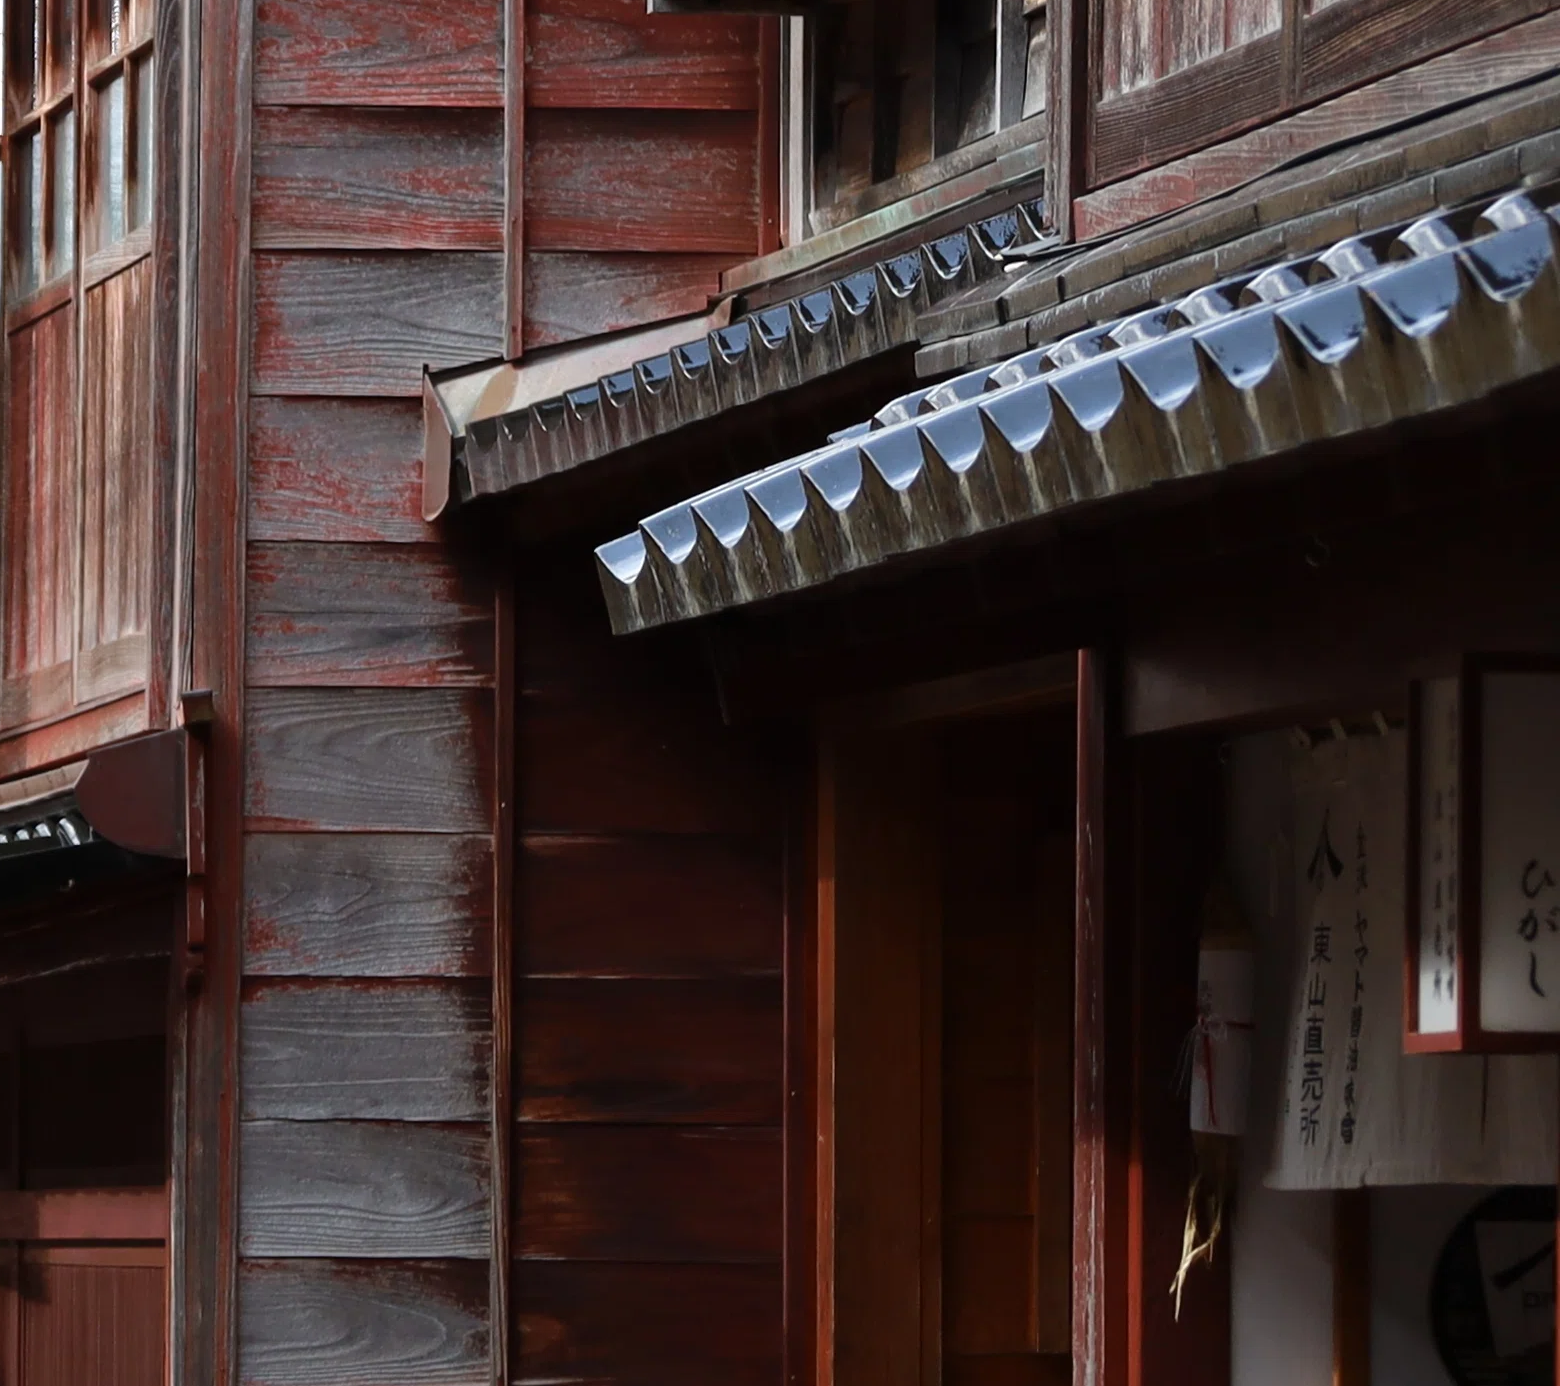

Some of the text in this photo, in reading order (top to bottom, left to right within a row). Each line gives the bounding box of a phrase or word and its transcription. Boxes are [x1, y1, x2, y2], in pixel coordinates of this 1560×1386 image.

[1517, 859, 1557, 998] ひがし
[1299, 921, 1333, 1146] 東山直売所
